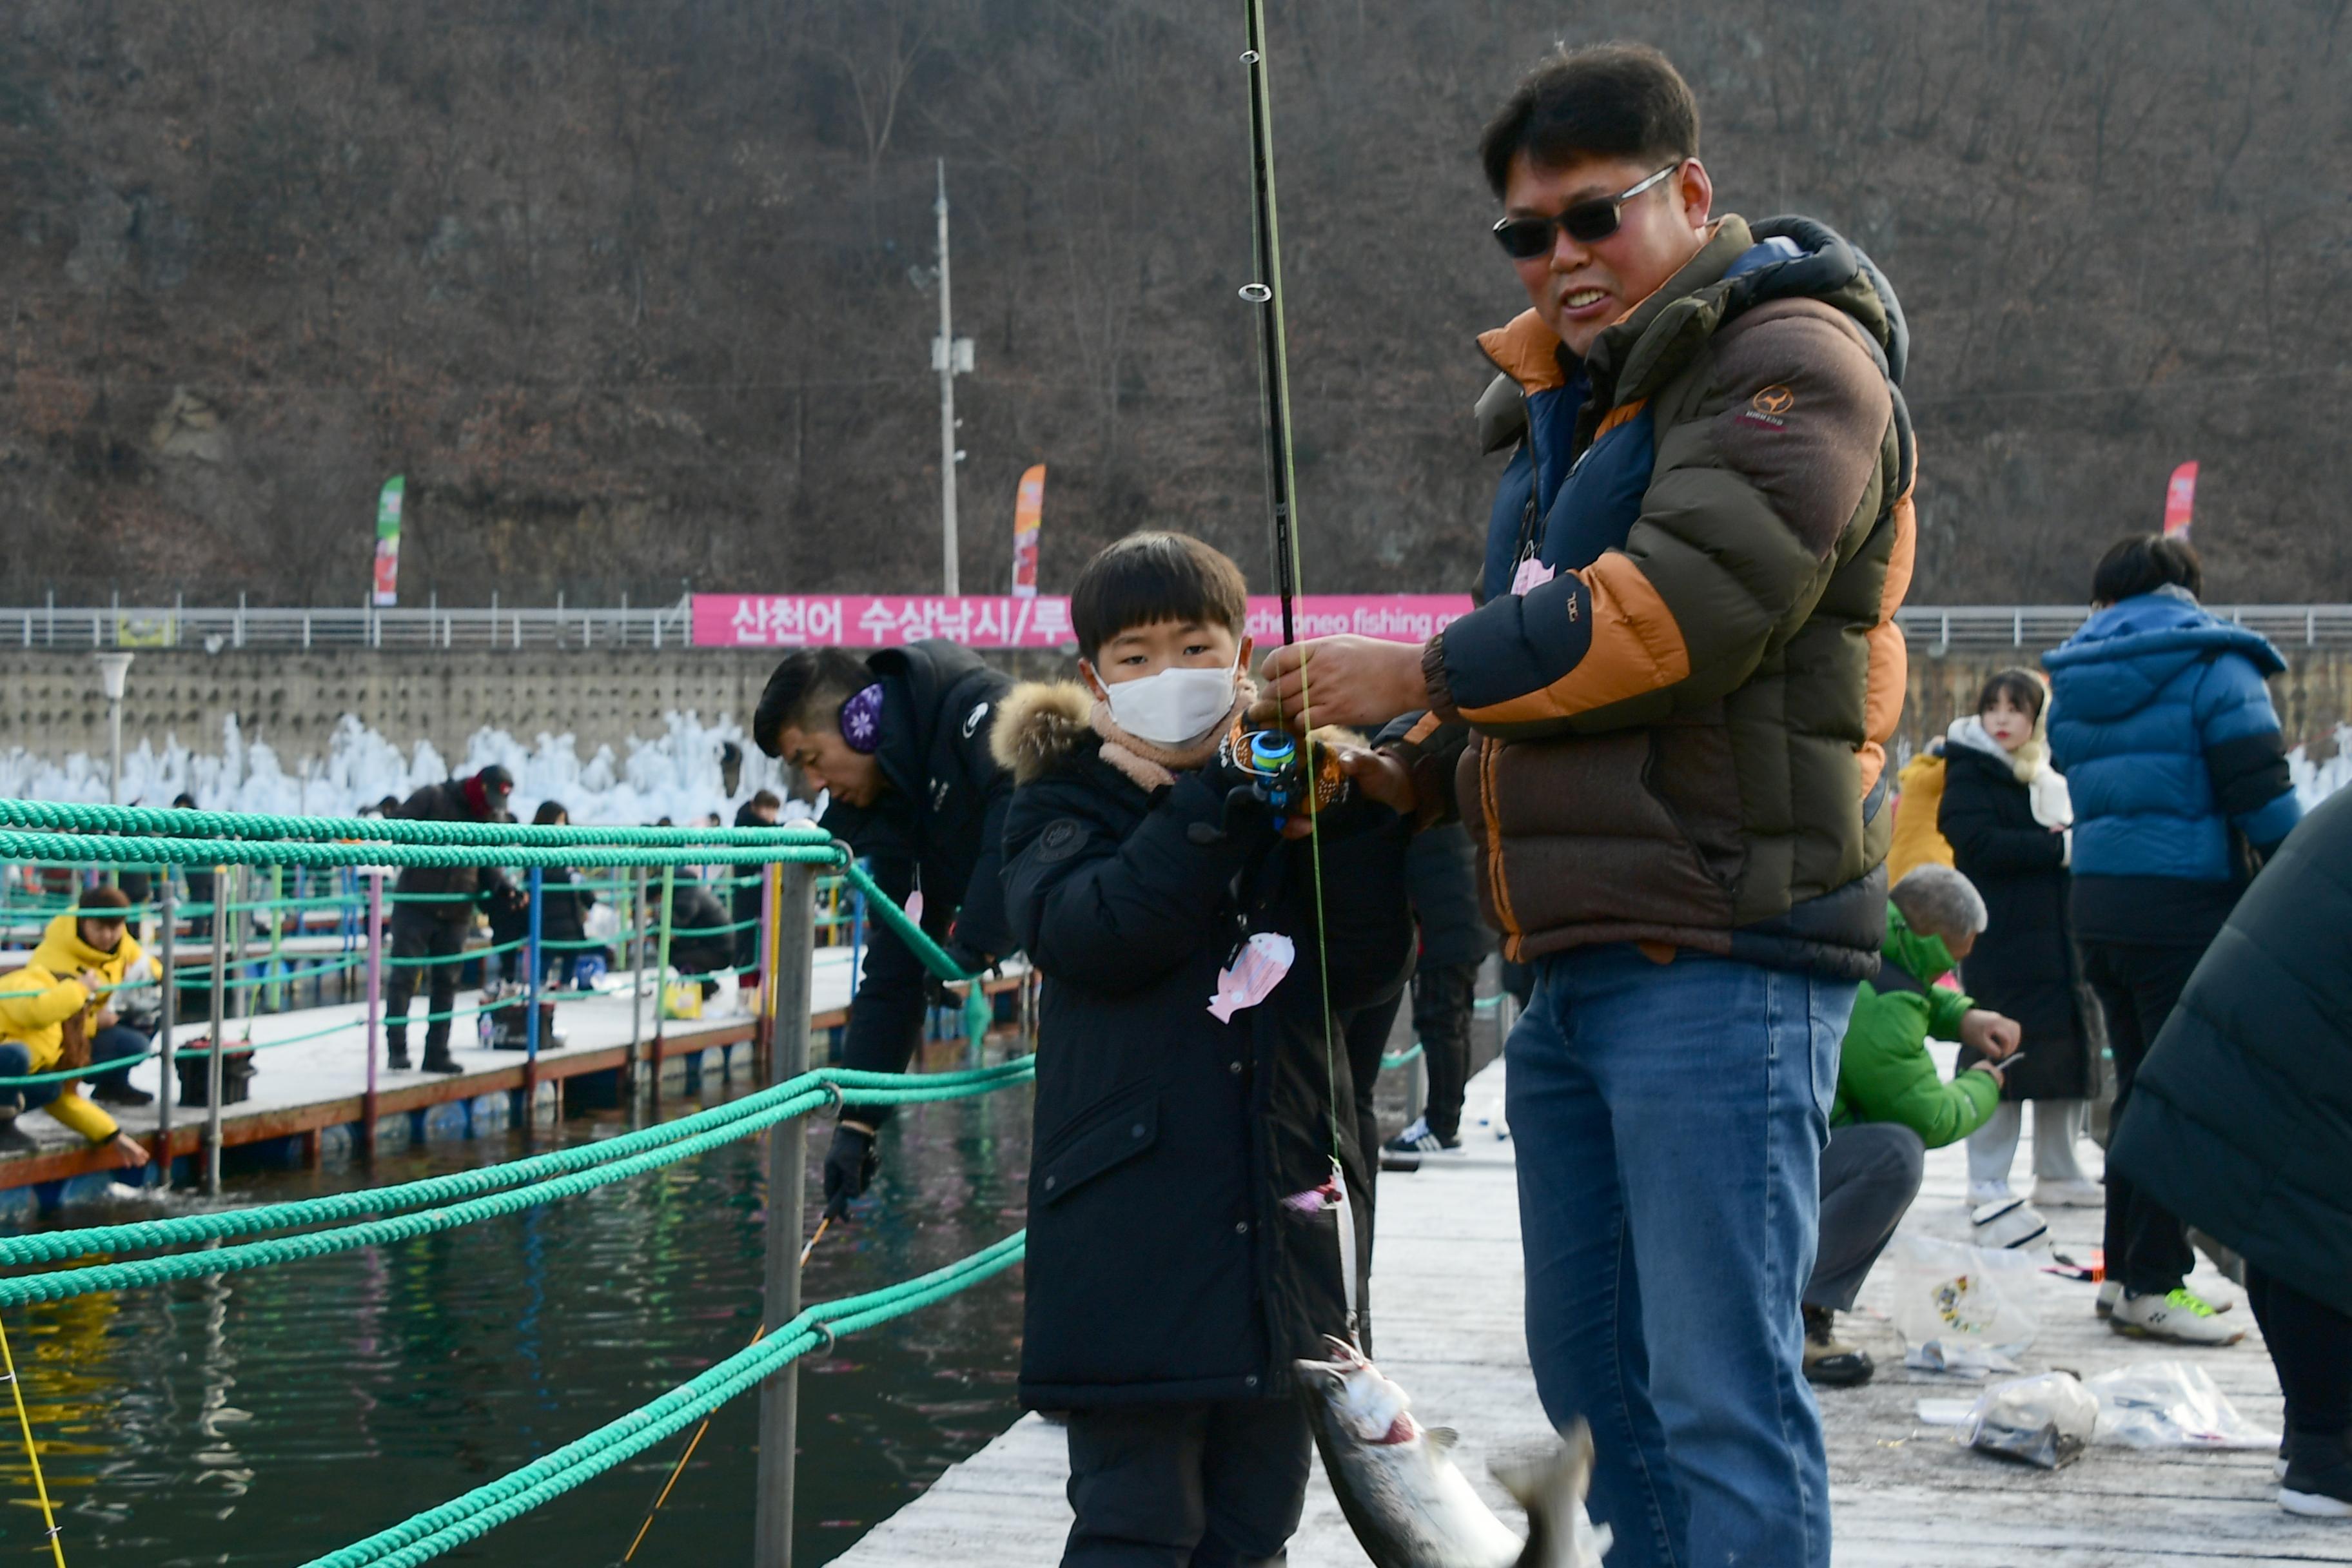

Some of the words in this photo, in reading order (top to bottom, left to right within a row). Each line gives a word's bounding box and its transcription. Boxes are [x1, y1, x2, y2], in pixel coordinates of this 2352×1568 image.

[731, 598, 843, 643] 산천어
[859, 598, 1070, 645] 수상낚시/루
[1244, 607, 1349, 635] cheoneo
[1353, 607, 1432, 640] fishing
